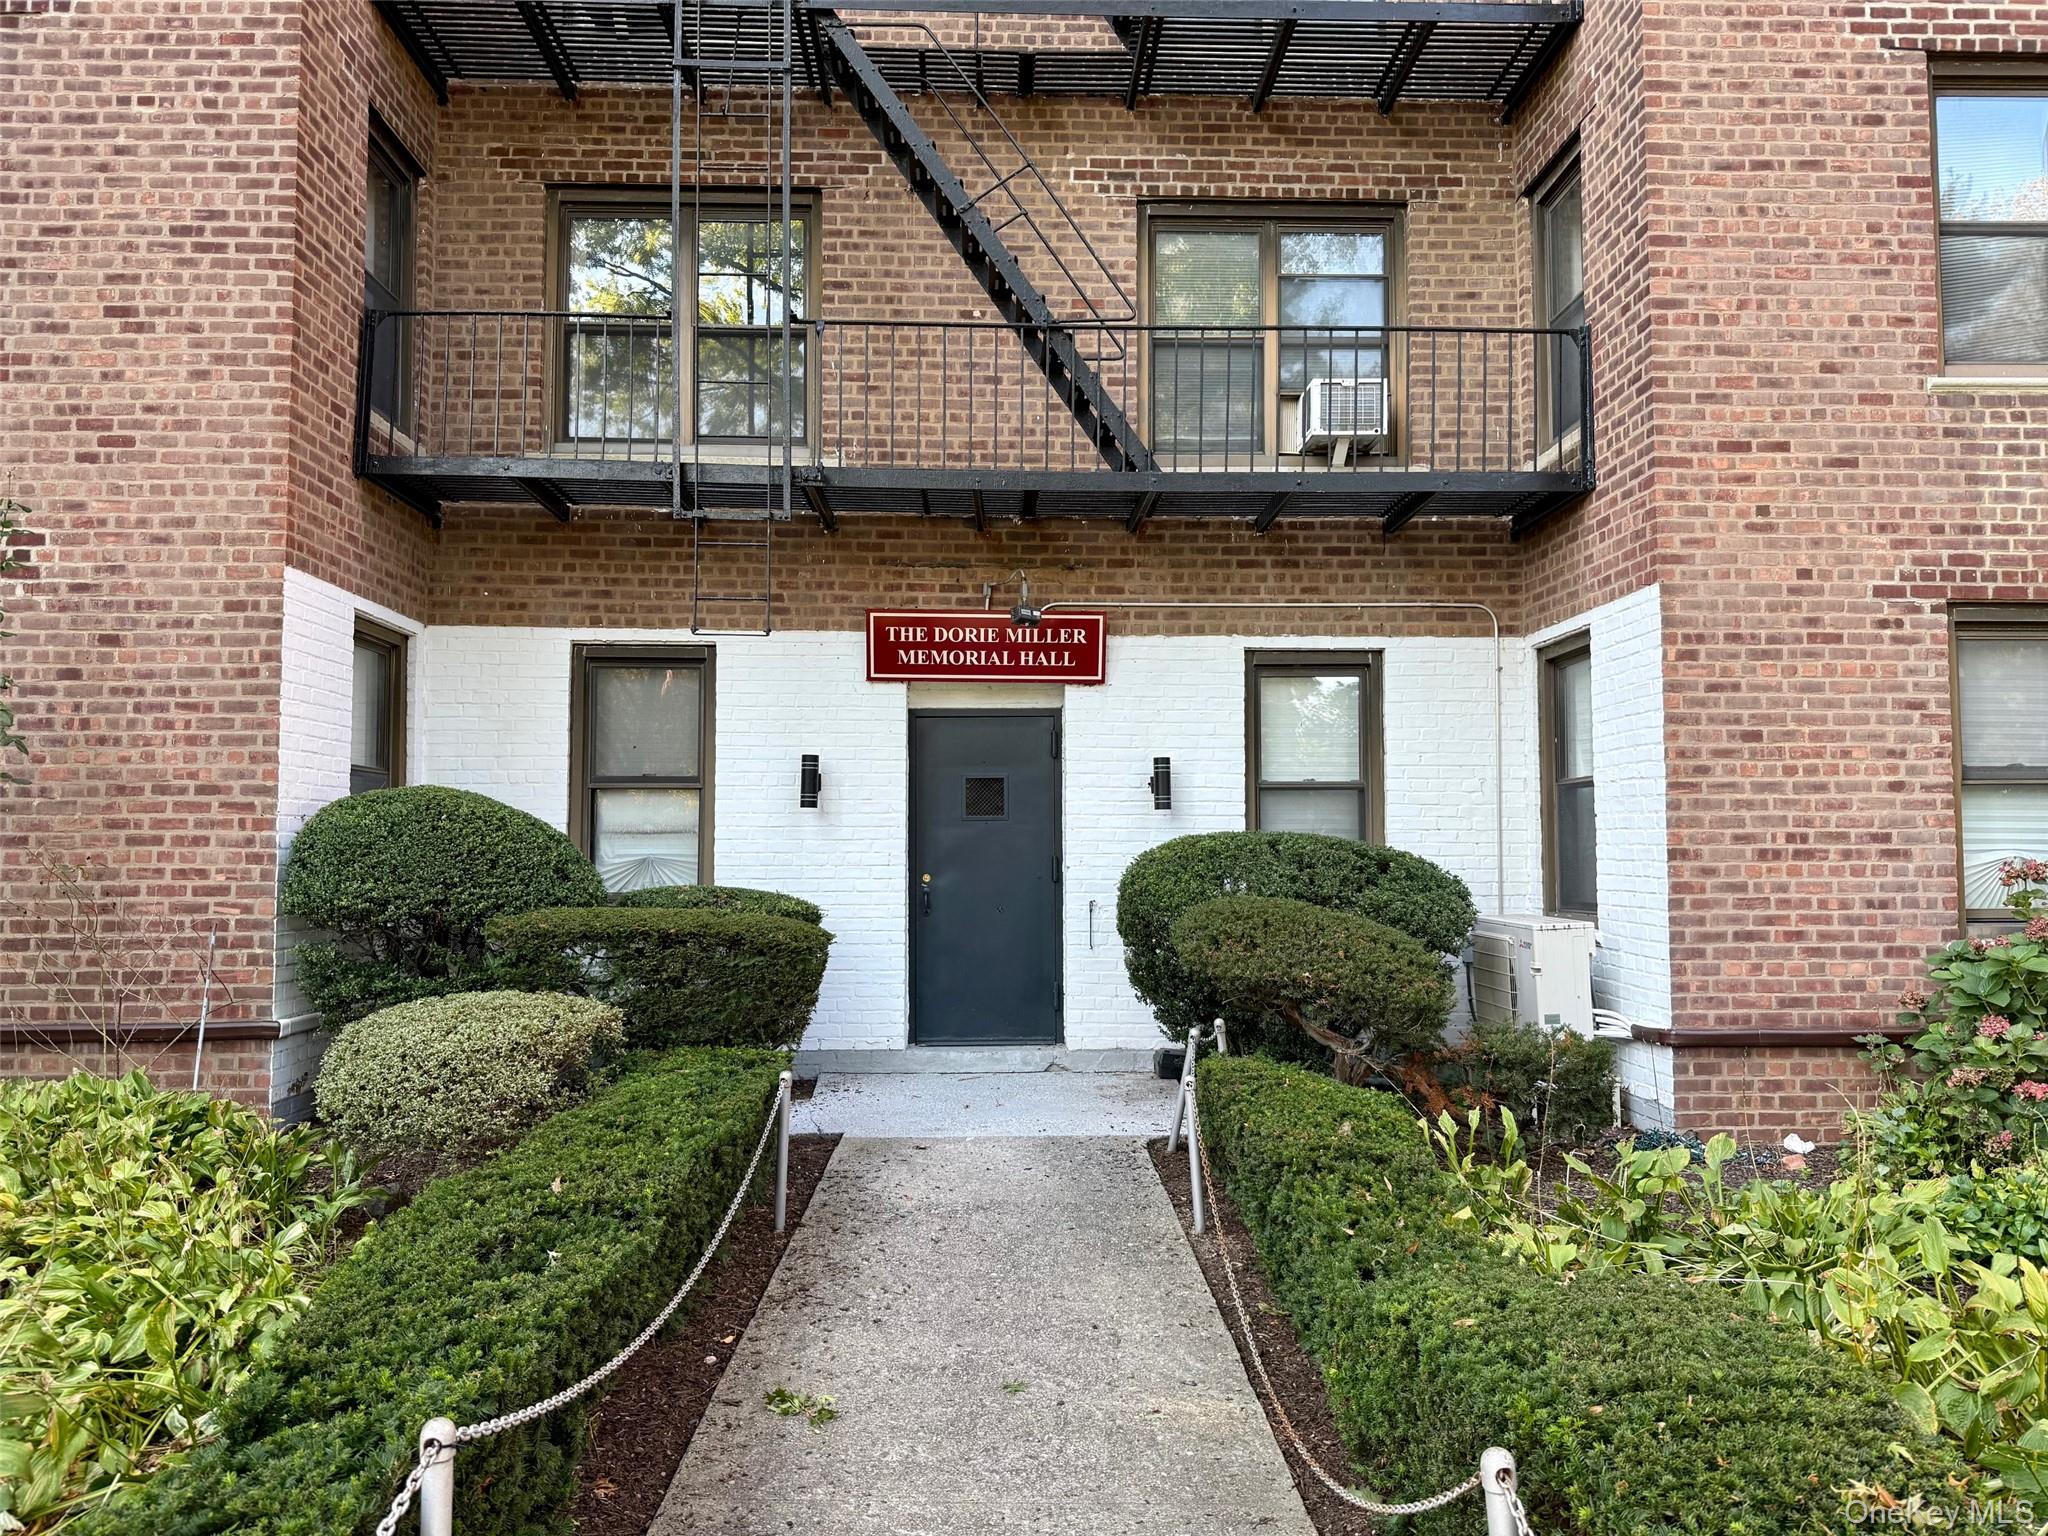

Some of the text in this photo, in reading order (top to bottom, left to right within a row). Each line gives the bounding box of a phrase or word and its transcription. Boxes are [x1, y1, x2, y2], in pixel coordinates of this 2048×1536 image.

[885, 626, 1087, 645] THE DORIE MILLER
[897, 649, 1076, 667] MEMORIAL HALL
